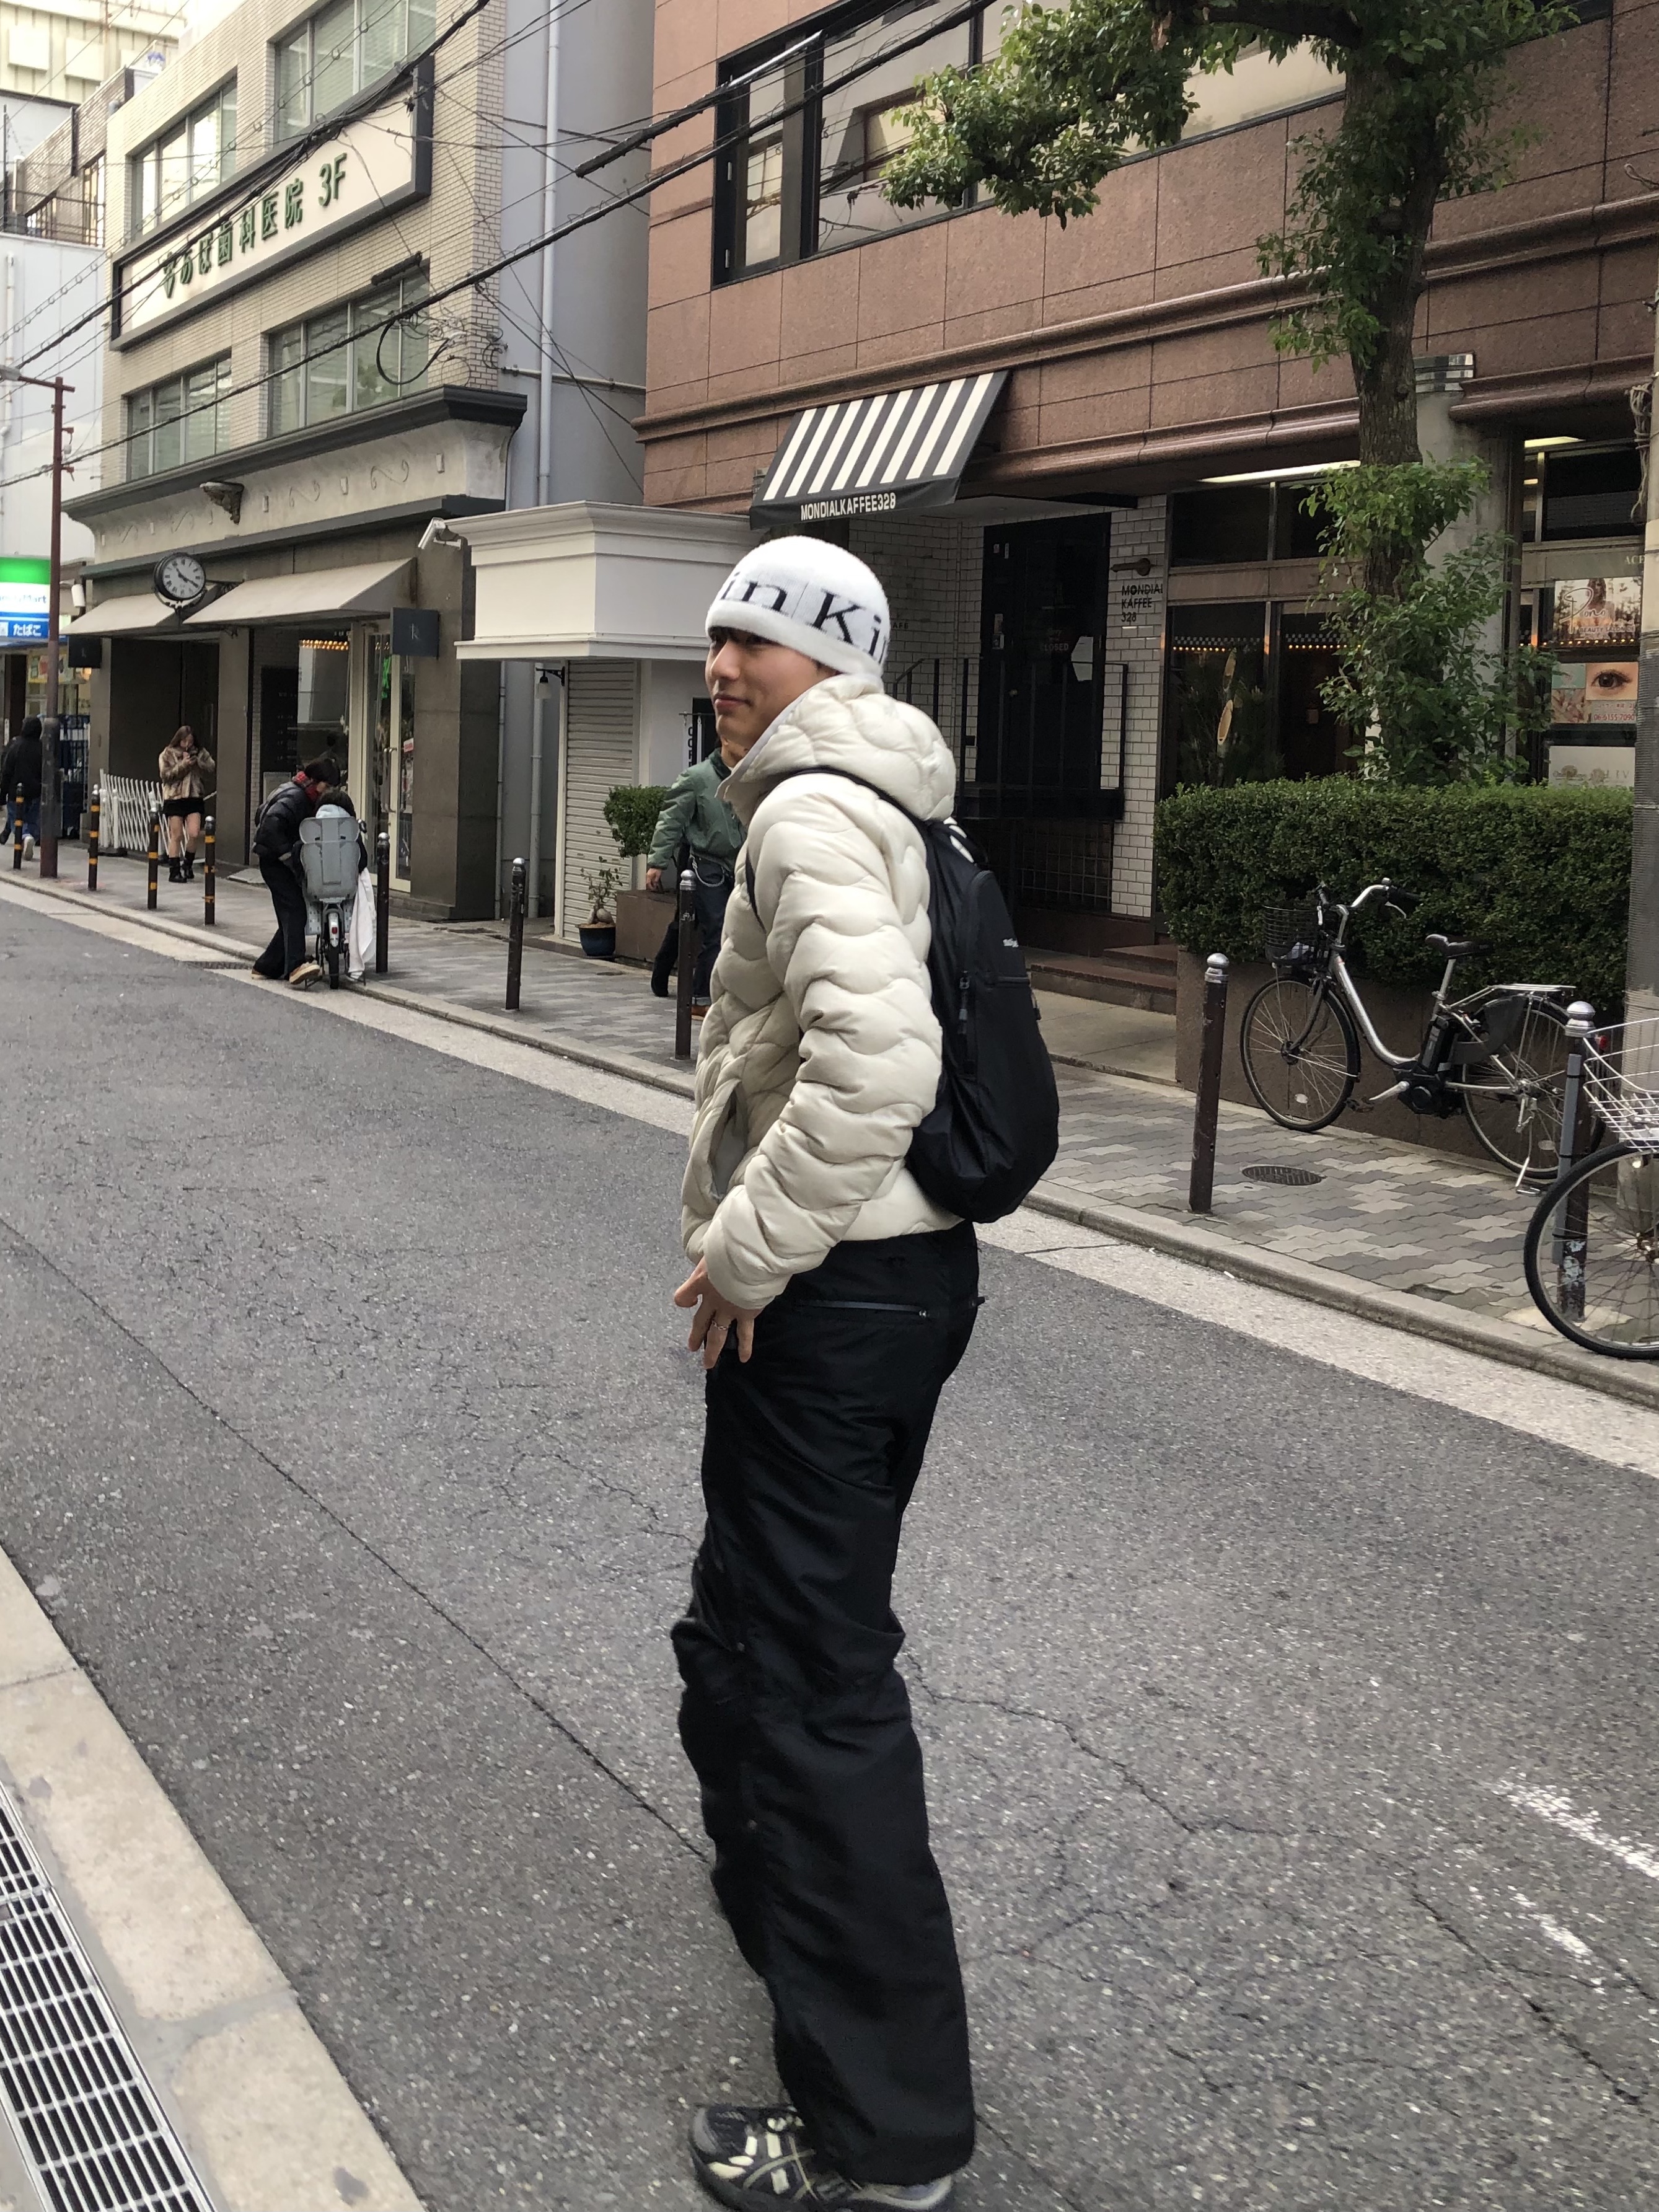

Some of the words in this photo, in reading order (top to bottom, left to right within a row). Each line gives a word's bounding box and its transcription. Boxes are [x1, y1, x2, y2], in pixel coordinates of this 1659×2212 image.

[318, 152, 347, 207] 3F
[801, 492, 896, 521] MONDIALKAFFEE328
[1121, 597, 1153, 609] KAFFEE
[1121, 612, 1137, 622] 328
[12, 624, 42, 637] たばこ
